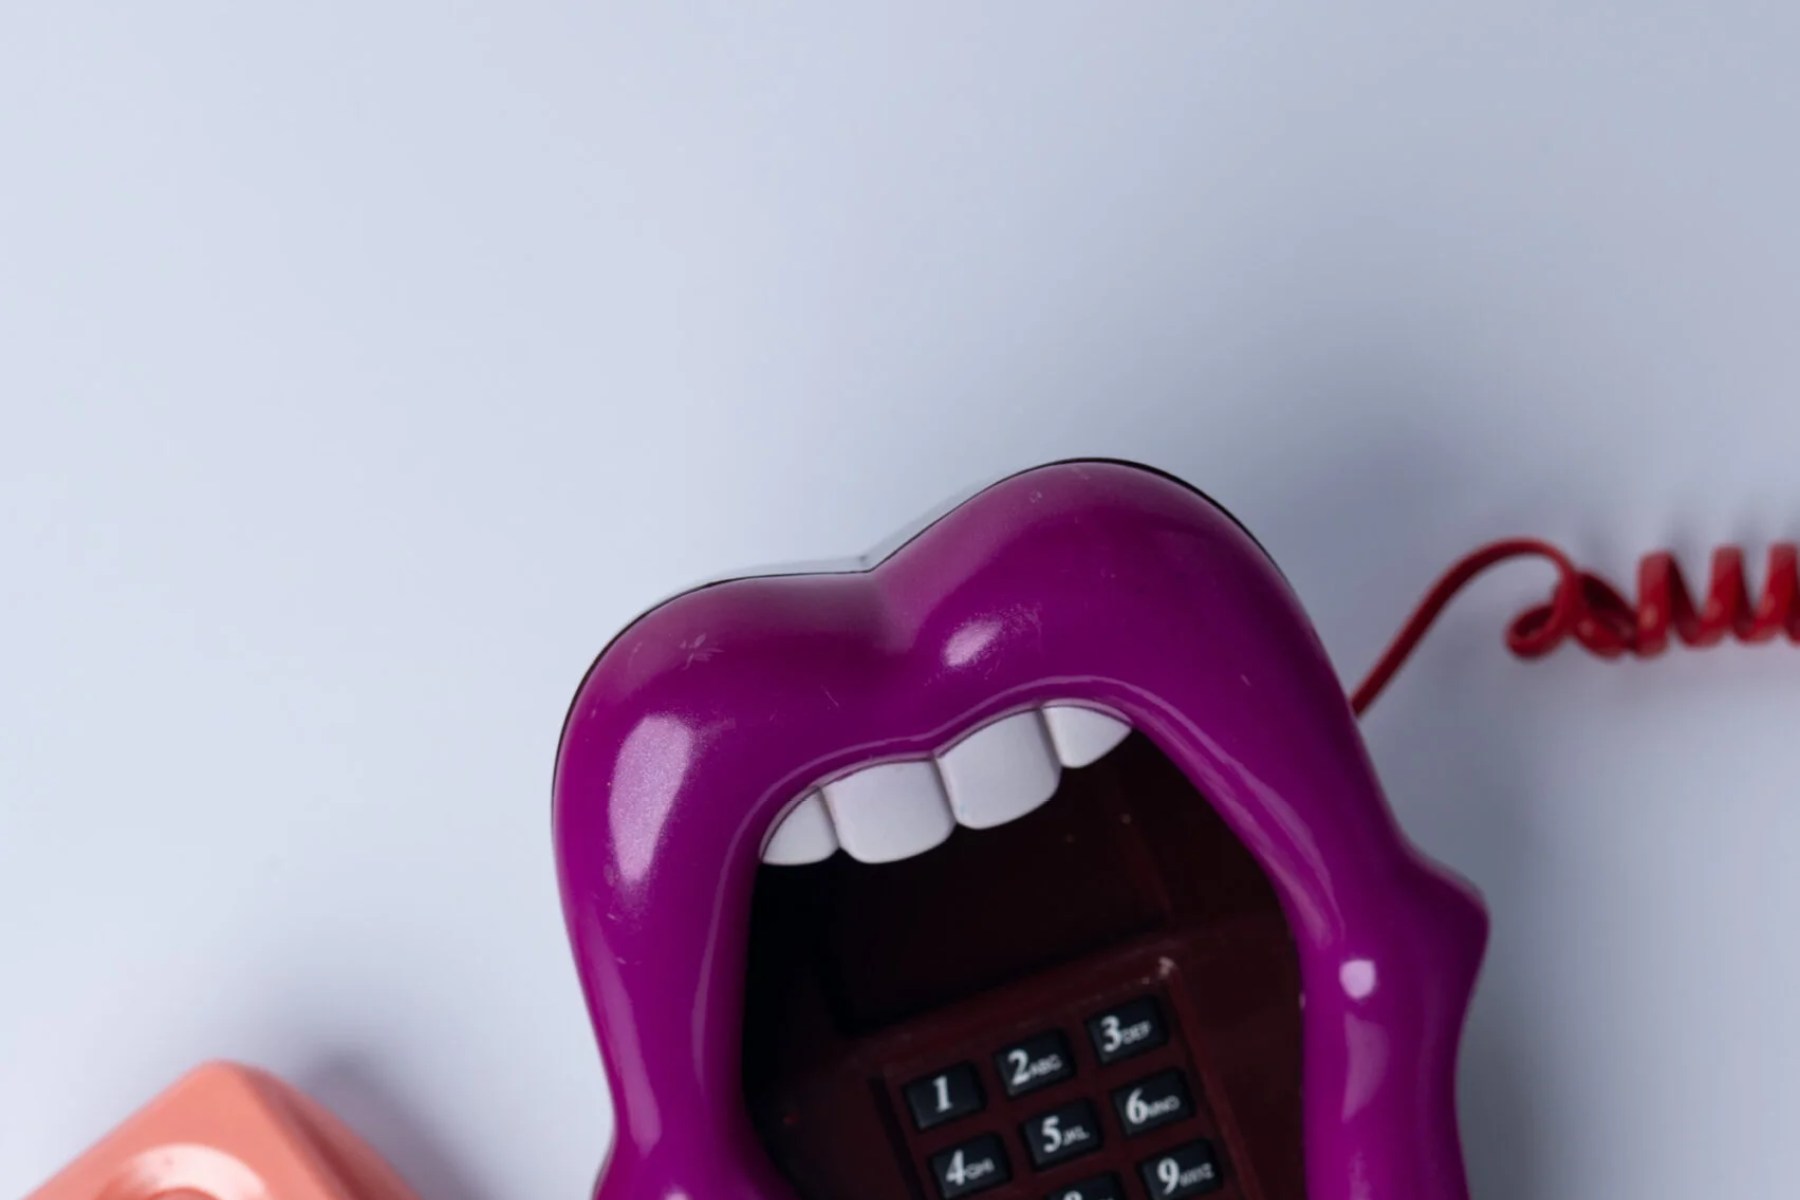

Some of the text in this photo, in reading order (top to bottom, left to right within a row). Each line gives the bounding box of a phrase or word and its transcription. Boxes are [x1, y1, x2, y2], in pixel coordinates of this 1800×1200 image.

[1101, 1015, 1122, 1051] 3
[1008, 1050, 1030, 1085] 2
[933, 1076, 951, 1112] 1
[1126, 1088, 1148, 1124] 6
[1041, 1116, 1063, 1152] 5
[946, 1150, 966, 1185] 4
[1157, 1158, 1180, 1195] 9
